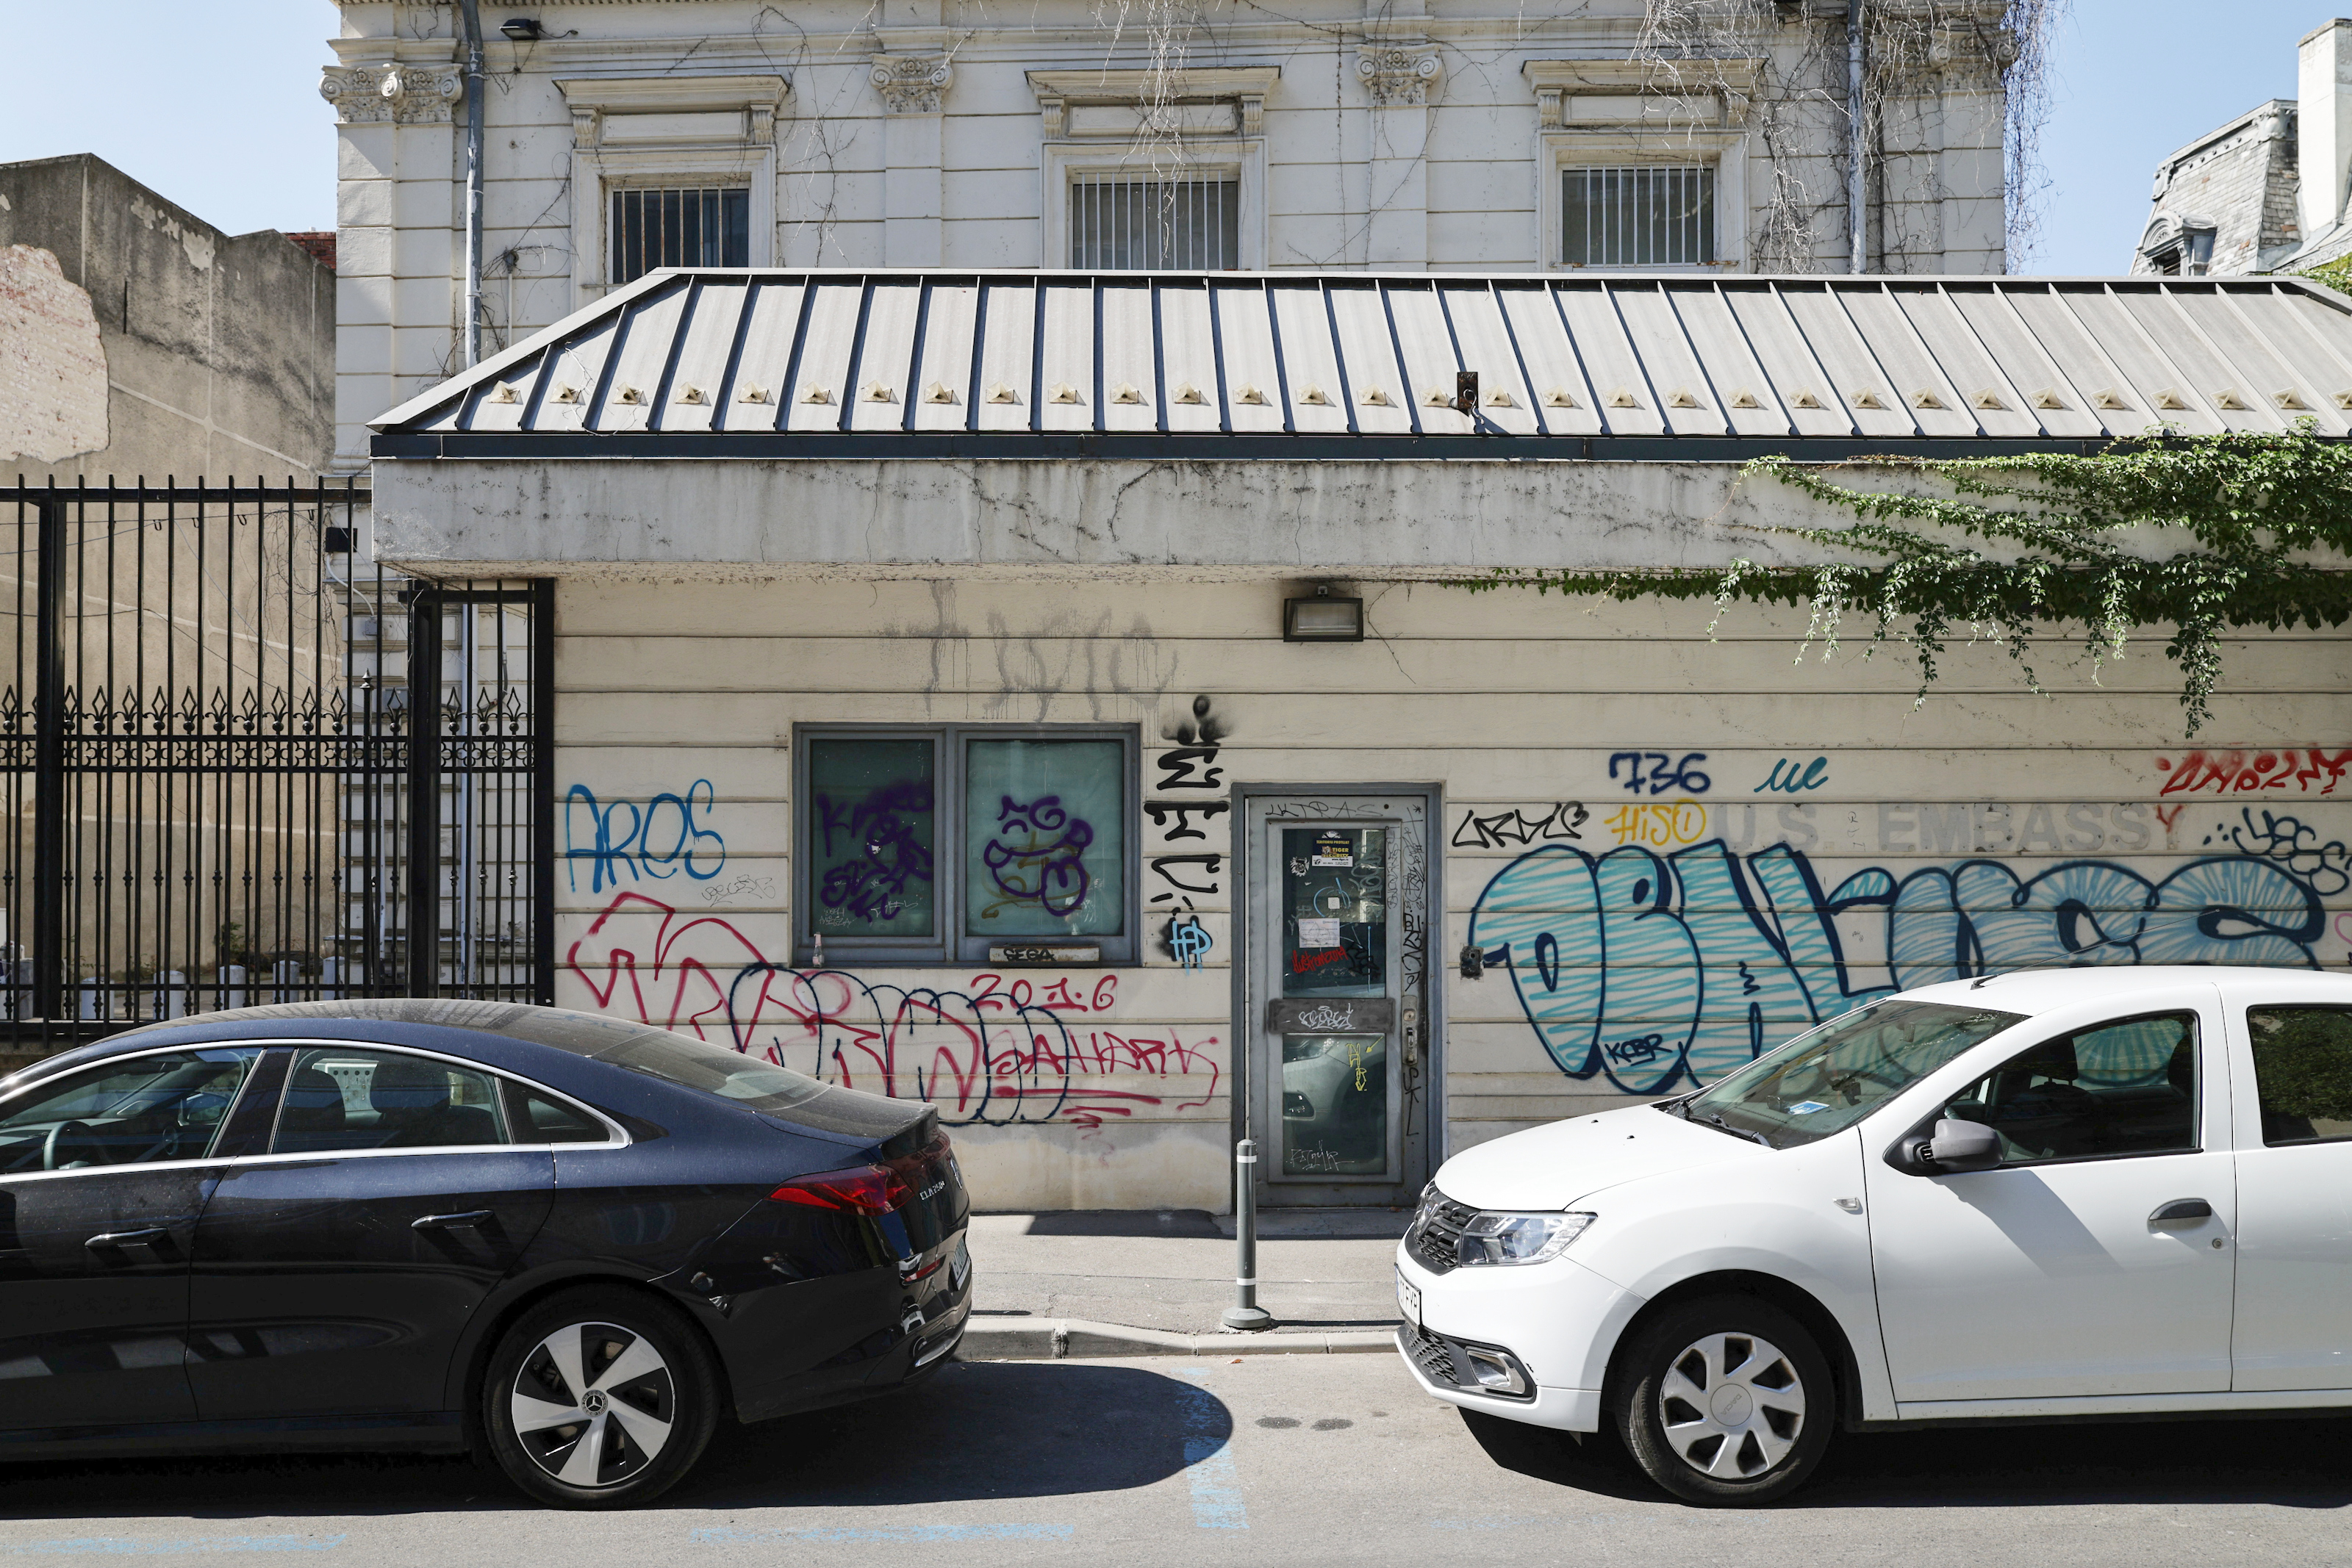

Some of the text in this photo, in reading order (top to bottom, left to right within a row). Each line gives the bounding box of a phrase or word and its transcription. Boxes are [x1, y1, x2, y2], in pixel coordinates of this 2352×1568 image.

[1610, 752, 1711, 794] 736
[1878, 802, 2183, 851] EMBASSY
[1003, 948, 1056, 962] SEGA
[1720, 1393, 1742, 1415] DACIA
